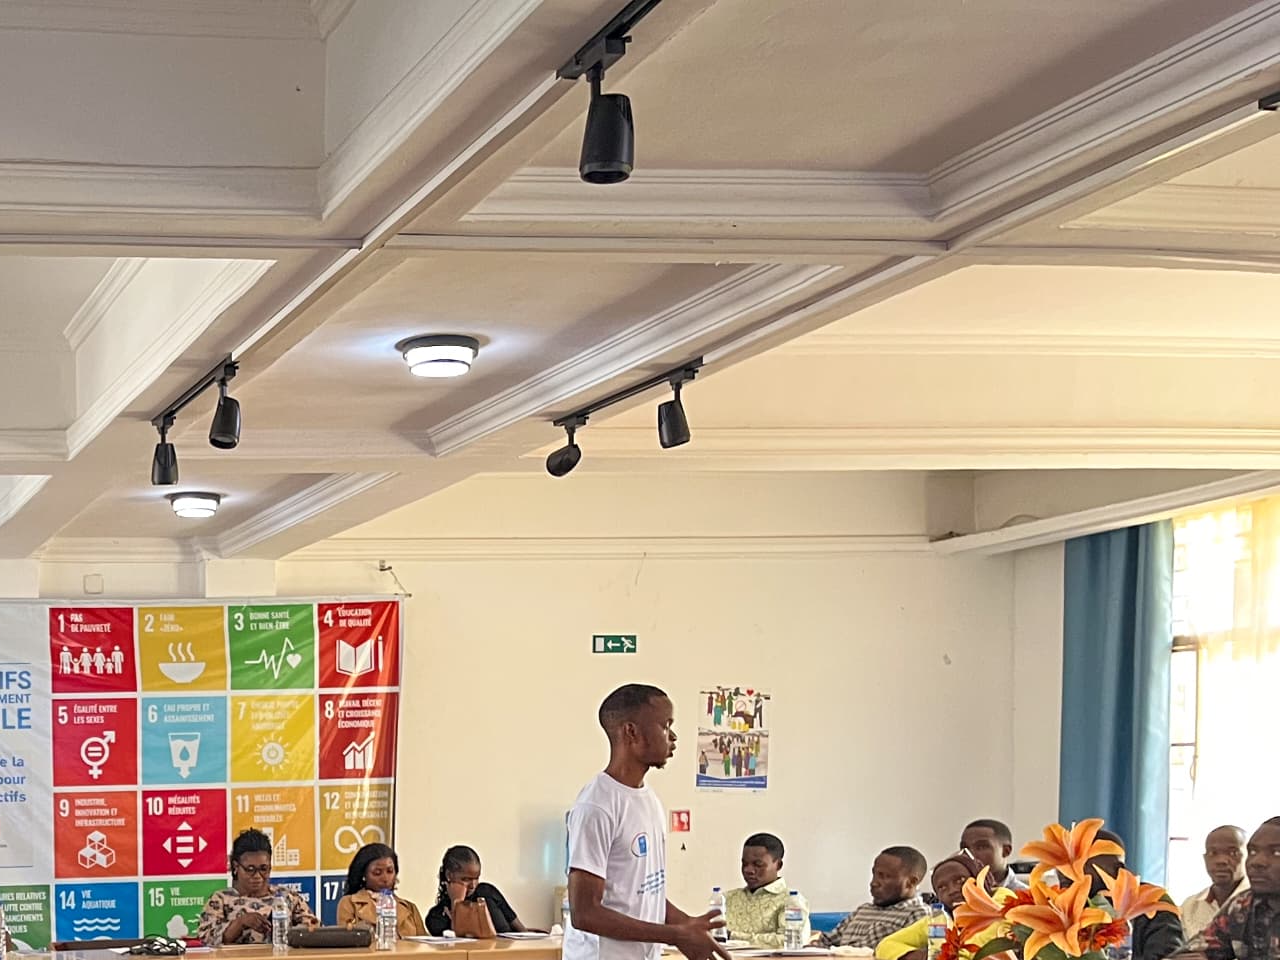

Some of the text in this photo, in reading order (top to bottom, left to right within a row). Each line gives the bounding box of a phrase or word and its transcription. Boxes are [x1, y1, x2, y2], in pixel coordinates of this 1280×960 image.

[58, 613, 64, 632] 1
[70, 613, 83, 622] PAS
[144, 614, 154, 632] 2
[234, 612, 244, 631] 3
[324, 610, 334, 628] 4
[70, 624, 80, 632] DE
[58, 706, 68, 724] 5
[74, 704, 118, 714] ÉGALITÉ ENTRE
[148, 704, 158, 722] 6
[238, 702, 246, 720] 7
[324, 700, 334, 720] 8
[74, 716, 84, 724] LES
[12, 756, 24, 767] la
[60, 798, 70, 817] 9
[146, 796, 164, 816] 10
[236, 794, 250, 813] 11
[323, 792, 340, 810] 12
[60, 890, 76, 910] 14
[82, 890, 92, 898] VIE
[148, 887, 165, 907] 15
[170, 887, 180, 896] VIE
[323, 882, 338, 900] 17
[82, 900, 116, 910] AQUATIQUE
